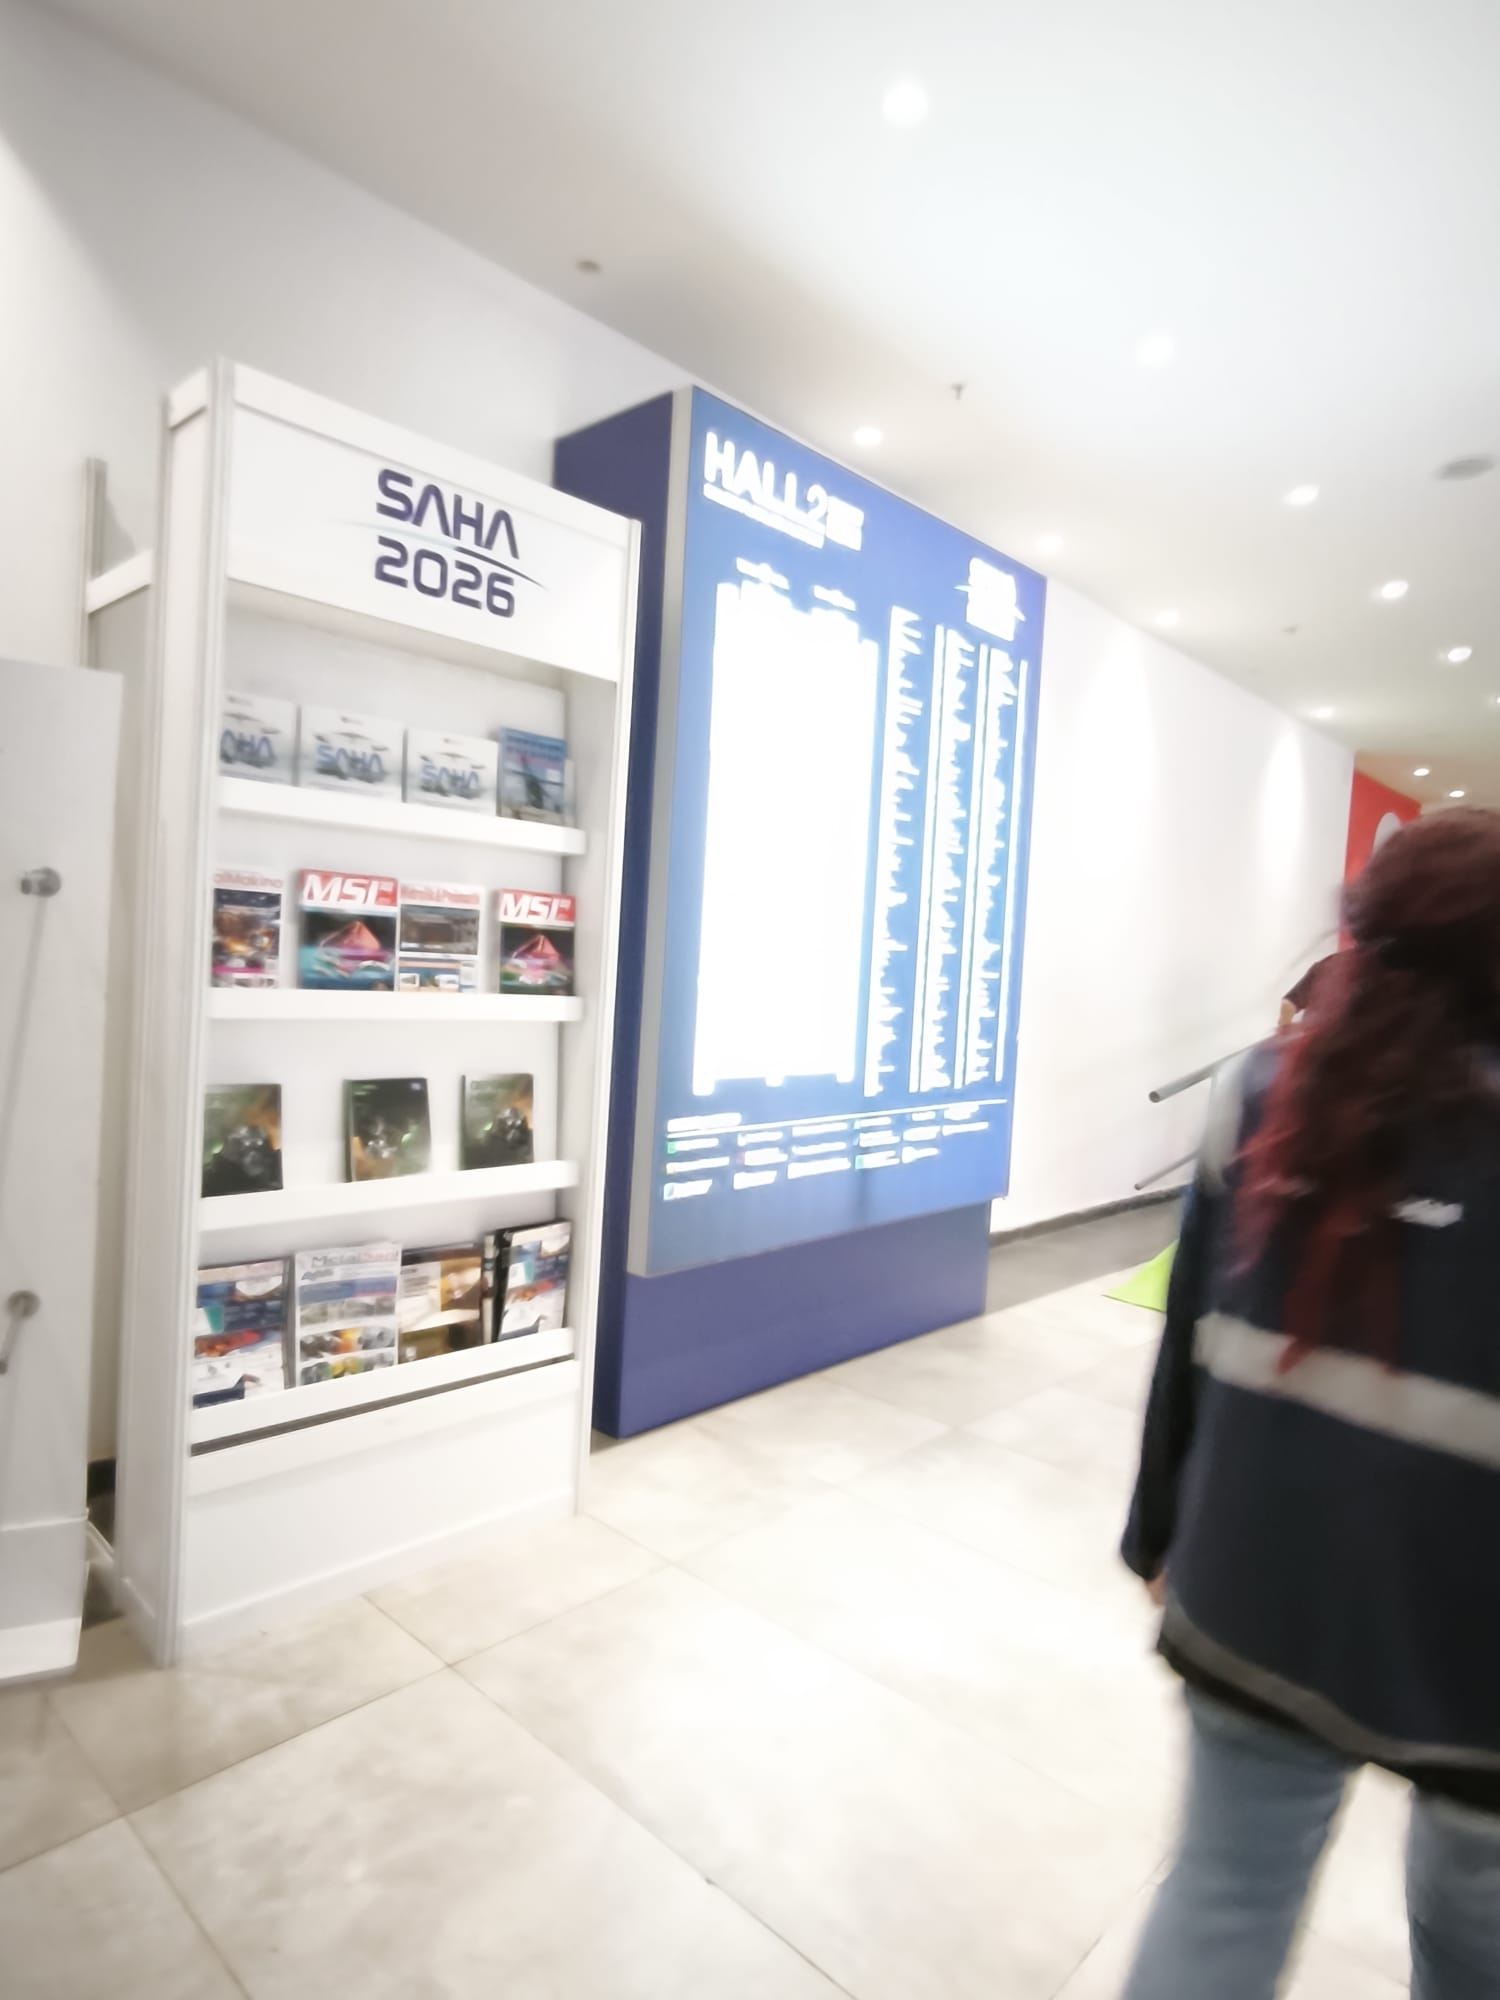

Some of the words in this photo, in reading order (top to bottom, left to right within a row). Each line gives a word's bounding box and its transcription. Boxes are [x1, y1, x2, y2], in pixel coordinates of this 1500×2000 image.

[376, 468, 520, 560] SAHA
[704, 431, 810, 521] HALL
[374, 535, 516, 618] 2026
[220, 729, 274, 764] AHA
